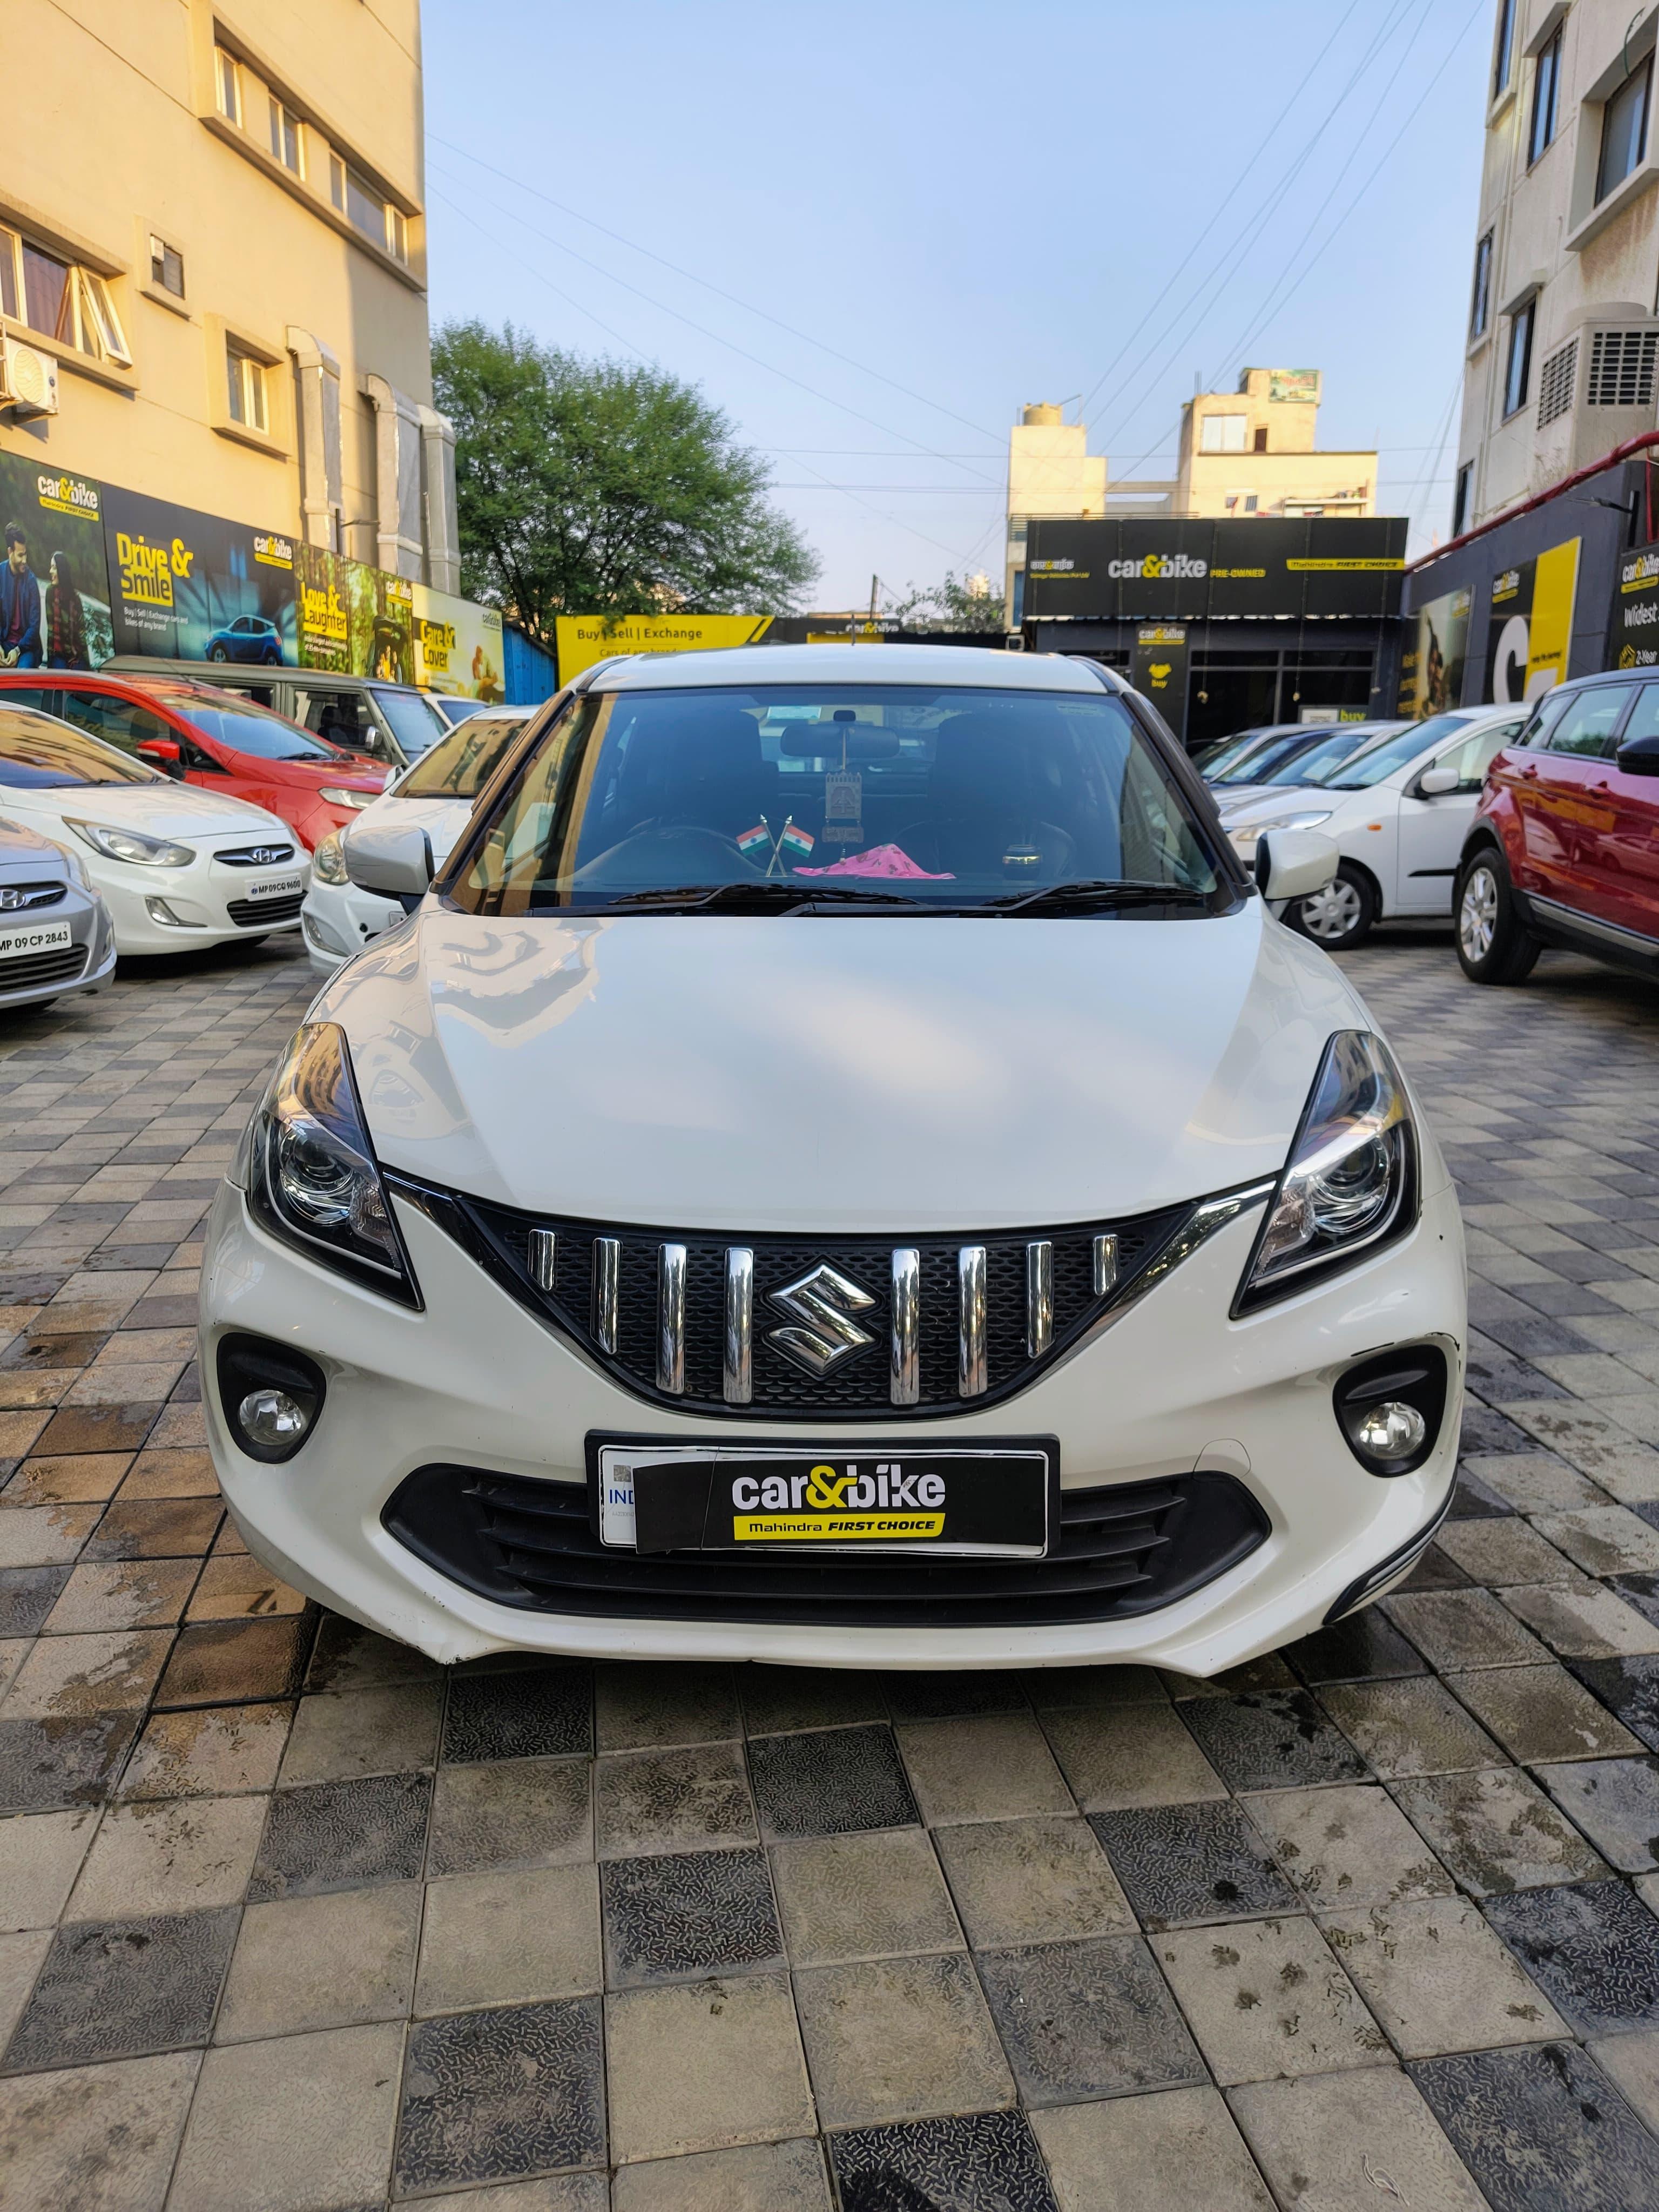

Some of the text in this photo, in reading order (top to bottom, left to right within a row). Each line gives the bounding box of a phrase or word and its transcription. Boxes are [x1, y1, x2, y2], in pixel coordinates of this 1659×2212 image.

[38, 476, 98, 509] car&bike
[117, 532, 193, 578] Drive &
[254, 536, 292, 560] car&bike
[1108, 554, 1208, 578] car&bike
[122, 569, 171, 600] Smile
[301, 581, 327, 607] Love
[421, 621, 444, 646] Care
[577, 629, 599, 641] Buy
[644, 628, 703, 640] Exchange
[424, 643, 448, 667] Cover
[600, 649, 618, 657] Cars
[15, 938, 28, 948] 09
[30, 935, 43, 946] CP
[46, 931, 68, 944] 2843
[732, 1464, 946, 1510] car&bike
[749, 1520, 935, 1532] Mahindra FIRST CHOICE
